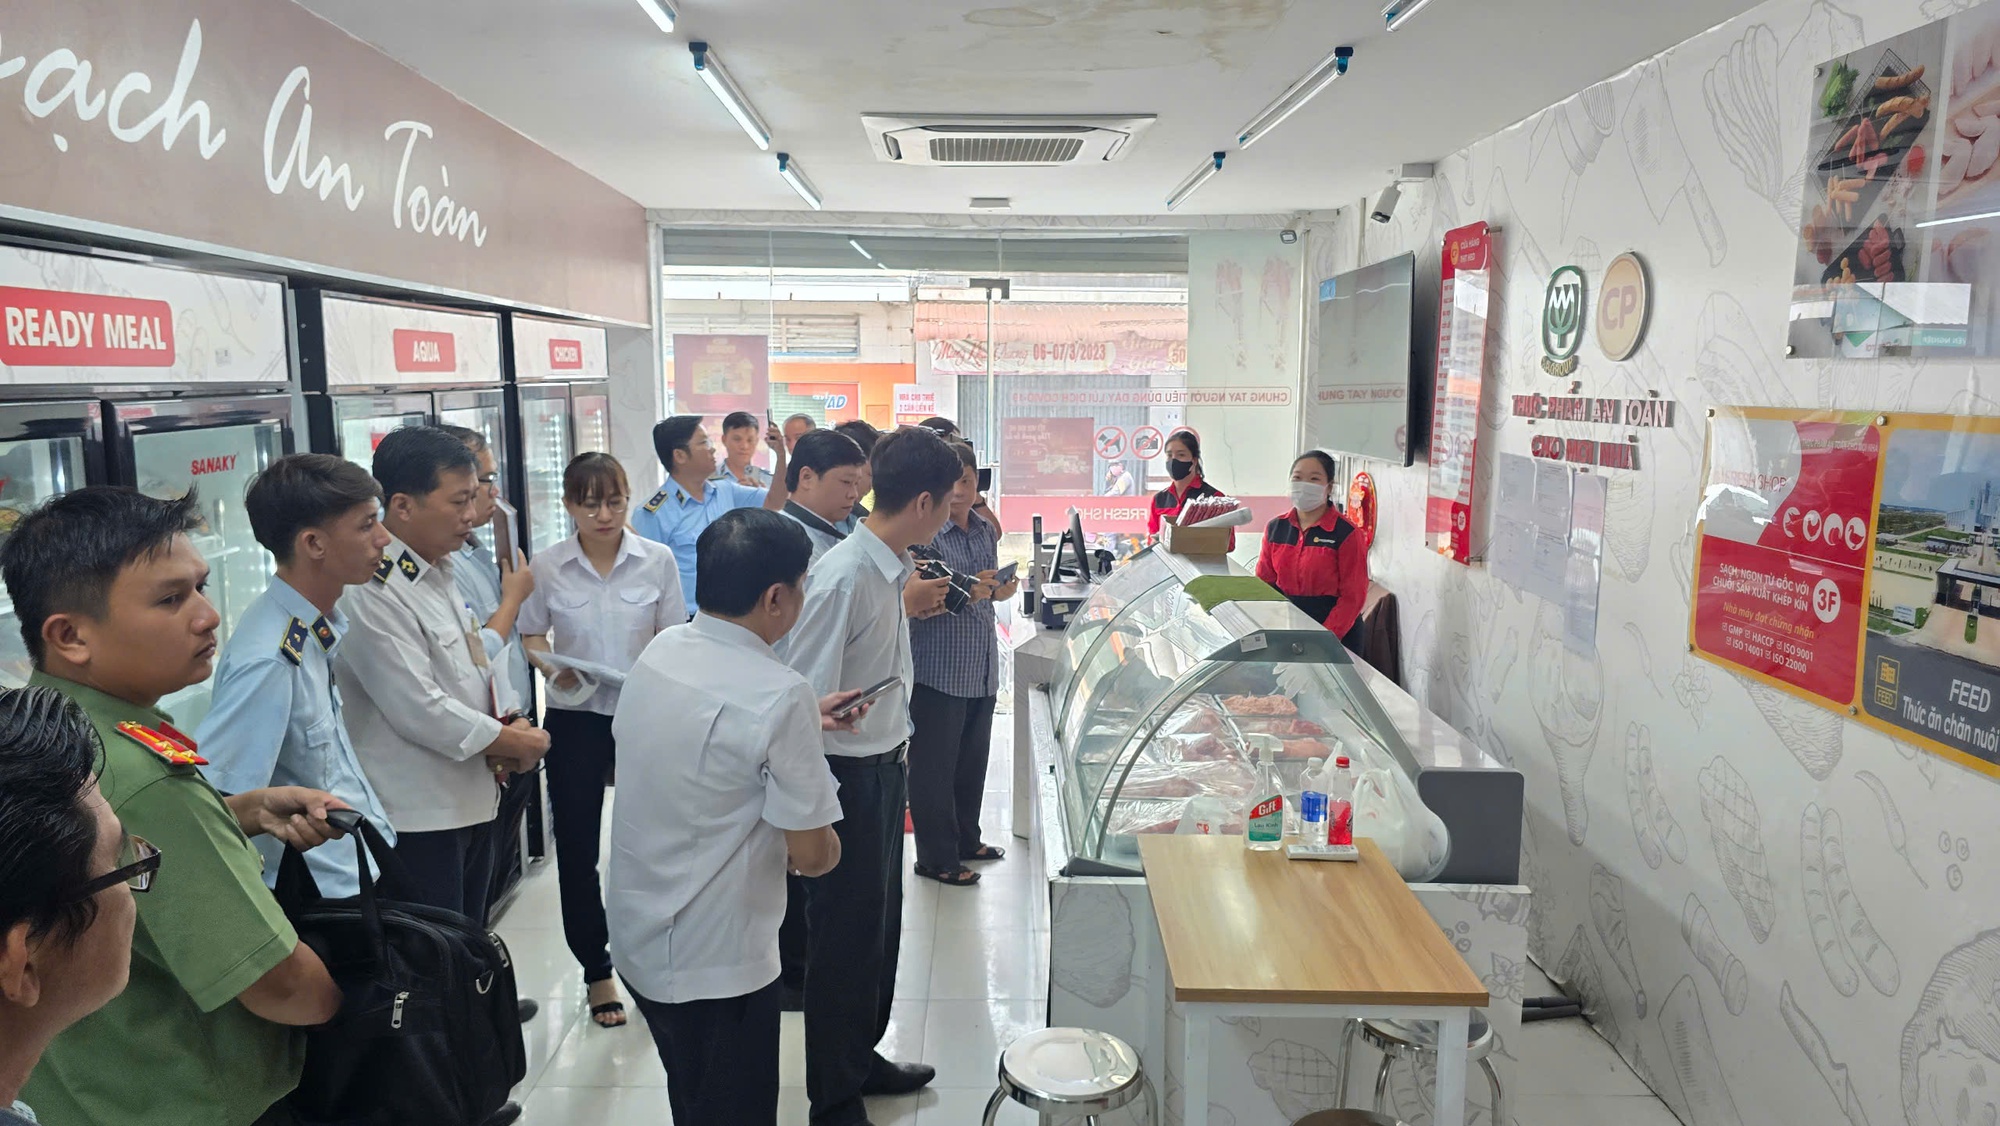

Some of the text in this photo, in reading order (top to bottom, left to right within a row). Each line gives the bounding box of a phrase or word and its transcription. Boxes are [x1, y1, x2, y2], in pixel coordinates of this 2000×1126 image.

[0, 18, 487, 248] ạch An Toàn
[1602, 285, 1637, 330] CP
[4, 306, 167, 350] READY MEAL
[413, 340, 440, 362] AQUA
[1033, 342, 1106, 362] 06-07/3/2023
[1347, 389, 1368, 399] TAY
[1591, 398, 1617, 424] AN
[1621, 390, 1671, 428] TOÀN
[191, 455, 237, 476] SANAKY
[1531, 434, 1638, 473] CHO MỌI NHÀ
[1741, 569, 1763, 583] NGON
[1764, 572, 1775, 586] TỪ
[1776, 573, 1794, 591] GỐC
[1795, 580, 1810, 597] VỚI
[1751, 585, 1771, 602] XUẤT
[1772, 591, 1792, 607] KHÉP
[1794, 596, 1808, 612] KÍN
[1817, 588, 1838, 613] 3F
[1723, 601, 1814, 640] Nhà máy đạt chứng nhận
[1728, 624, 1814, 662] GMP HACCP ISO 9001
[1732, 637, 1807, 674] ISO 14001 ISO 22000
[1878, 689, 1894, 705] FEED
[1949, 678, 1991, 713] FEED
[1902, 695, 2000, 753] Thức ăn chăn nuôi
[1258, 800, 1277, 816] Gift
